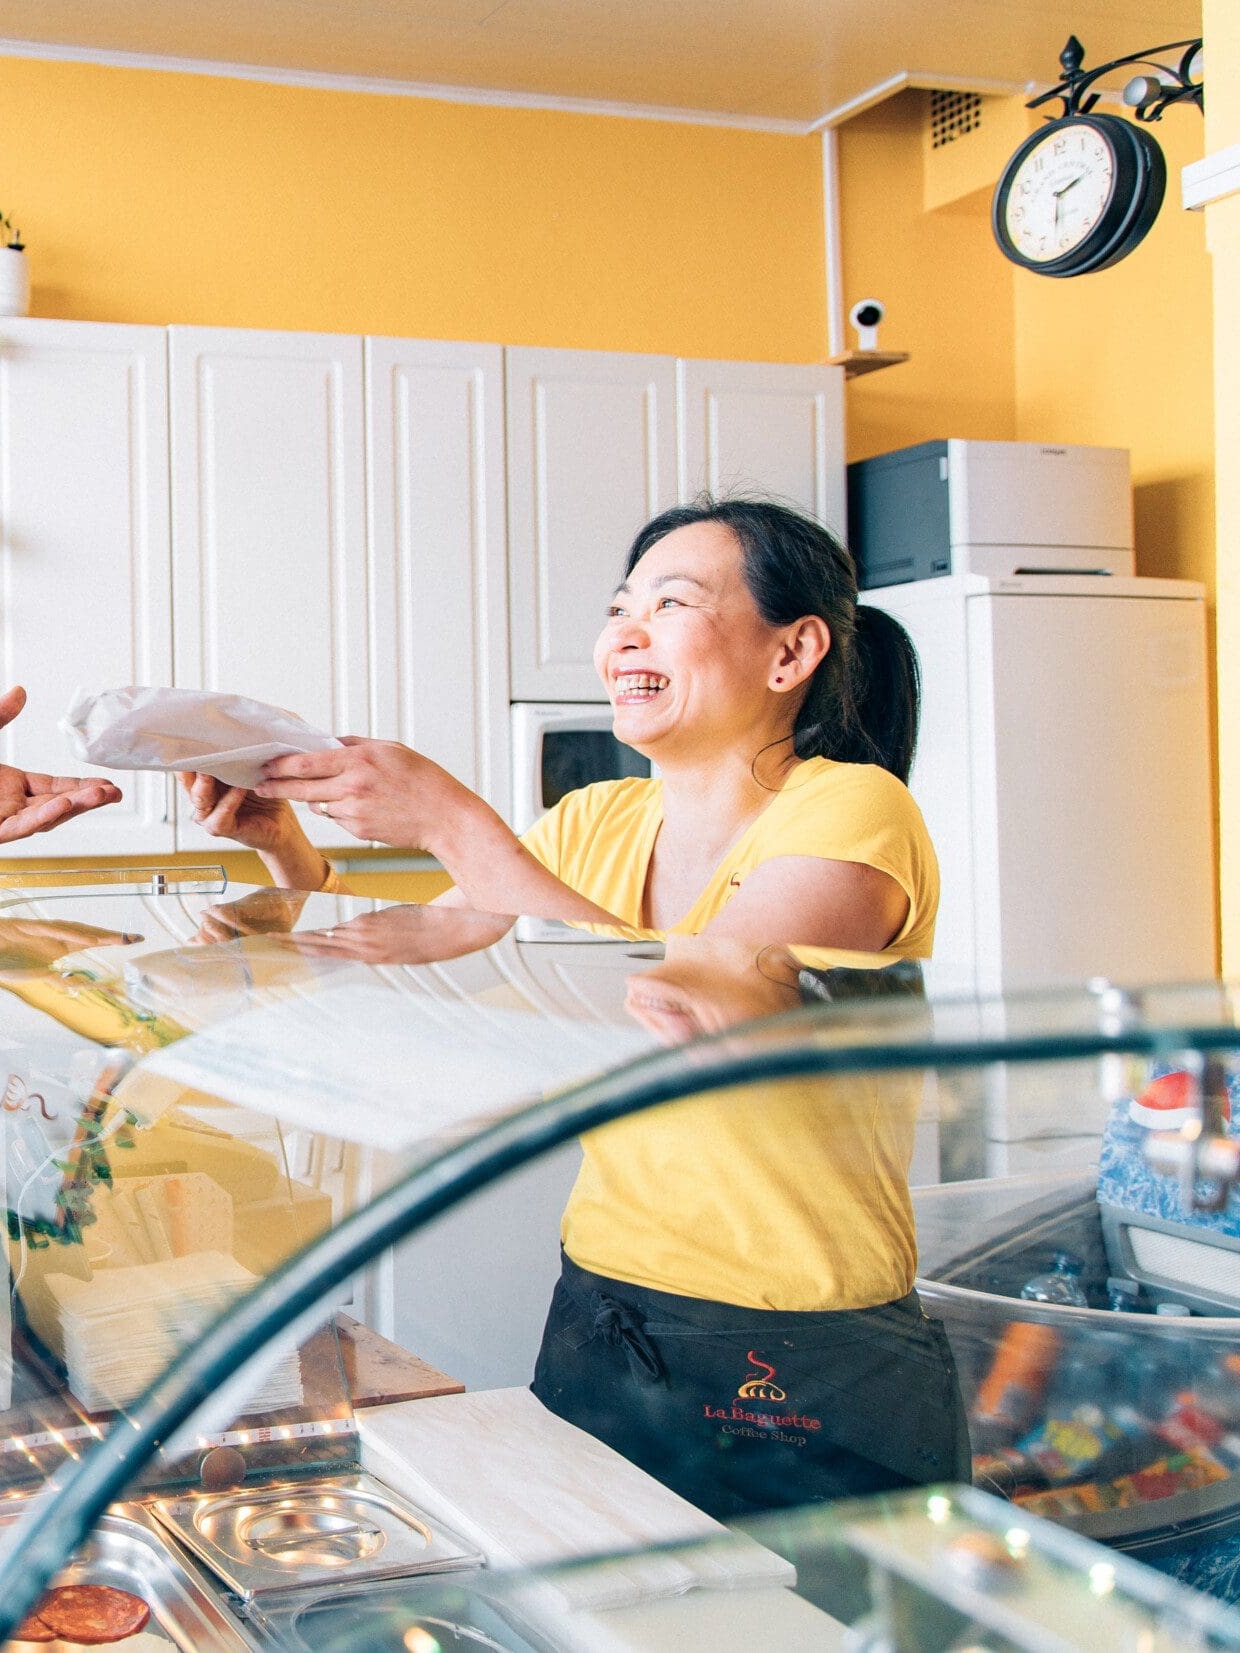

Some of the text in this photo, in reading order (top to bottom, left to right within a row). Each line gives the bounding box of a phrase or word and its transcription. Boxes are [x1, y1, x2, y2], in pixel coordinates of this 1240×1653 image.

[703, 1404, 822, 1432] La Baguette
[721, 1424, 807, 1447] Coffee Shop
